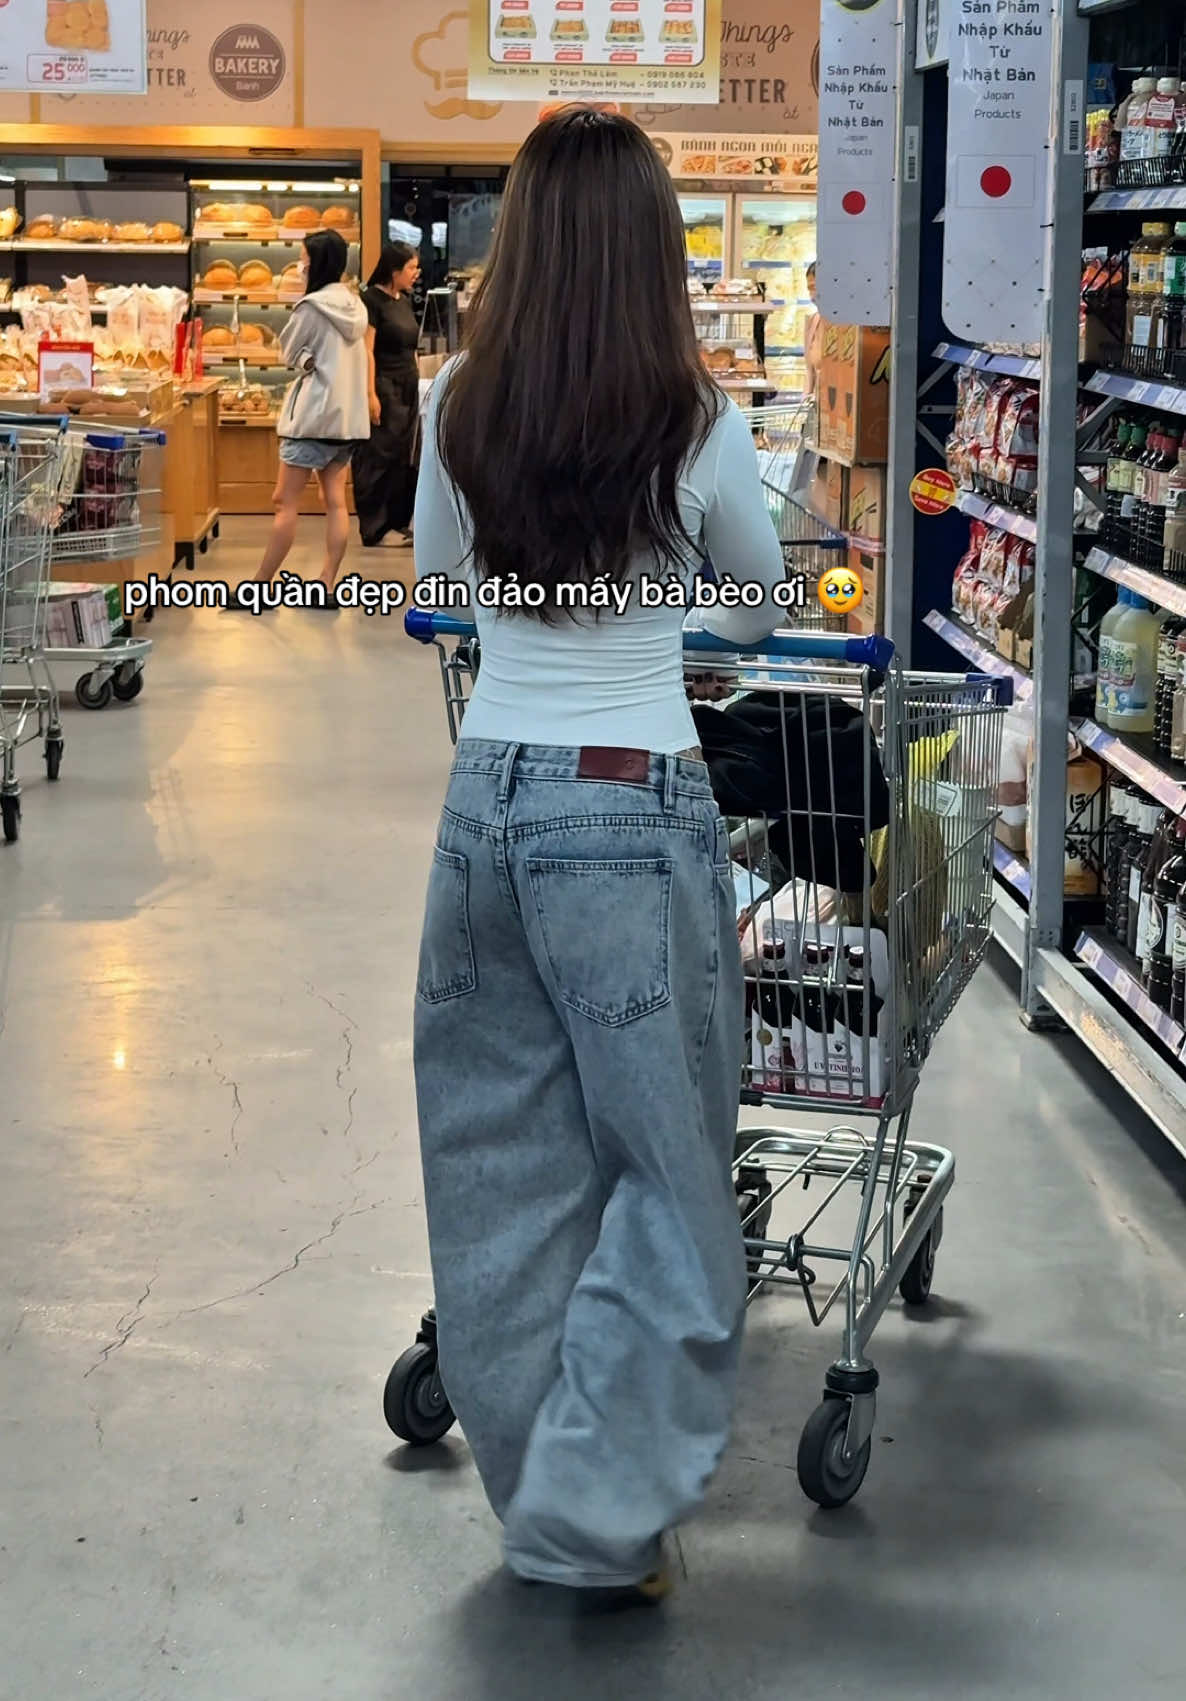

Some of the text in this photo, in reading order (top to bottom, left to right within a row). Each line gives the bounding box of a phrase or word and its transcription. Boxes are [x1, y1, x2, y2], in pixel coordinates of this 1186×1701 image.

[958, 23, 998, 40] Nhập
[989, 45, 1011, 58] Từ
[42, 62, 65, 81] 25
[214, 58, 280, 74] BAKERY
[827, 64, 849, 76] Sản
[962, 67, 1036, 85] Nhật Bản
[824, 82, 854, 95] Nhập
[983, 90, 1015, 101] Japan
[974, 108, 1022, 119] Products
[828, 115, 884, 129] Nhật Bản
